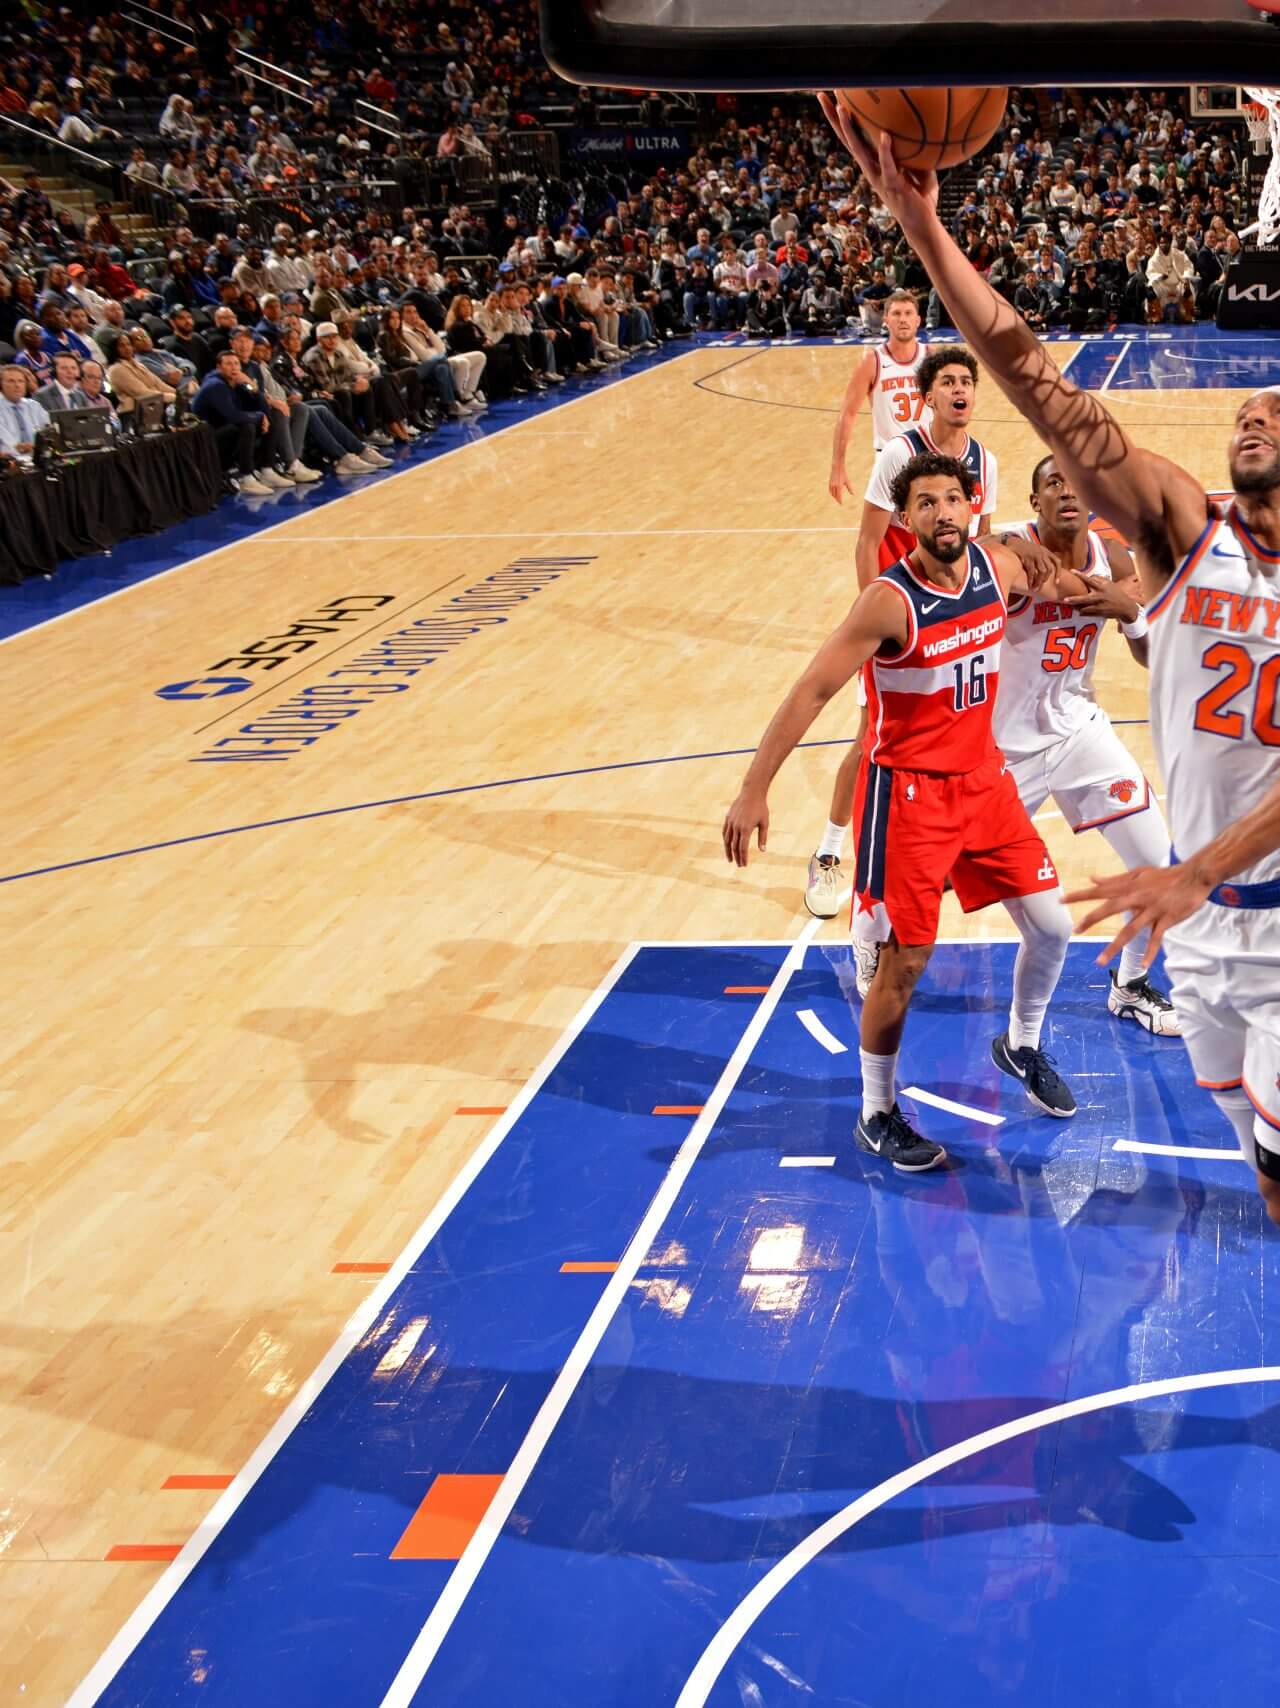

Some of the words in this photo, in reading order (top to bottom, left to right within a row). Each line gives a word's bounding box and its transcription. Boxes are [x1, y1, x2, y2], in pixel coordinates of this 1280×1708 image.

[635, 137, 680, 149] ULTRA
[706, 339, 803, 347] NEW
[831, 337, 957, 346] YOK
[893, 392, 926, 422] 37
[434, 556, 598, 613] MADISON
[206, 595, 396, 670] CHASE
[1032, 603, 1072, 624] NEW
[1180, 586, 1260, 633] NEW
[327, 616, 508, 677] SQUARE
[923, 615, 1003, 658] washington
[1041, 623, 1098, 672] 50
[954, 655, 988, 712] 16
[188, 683, 410, 762] GARDEN
